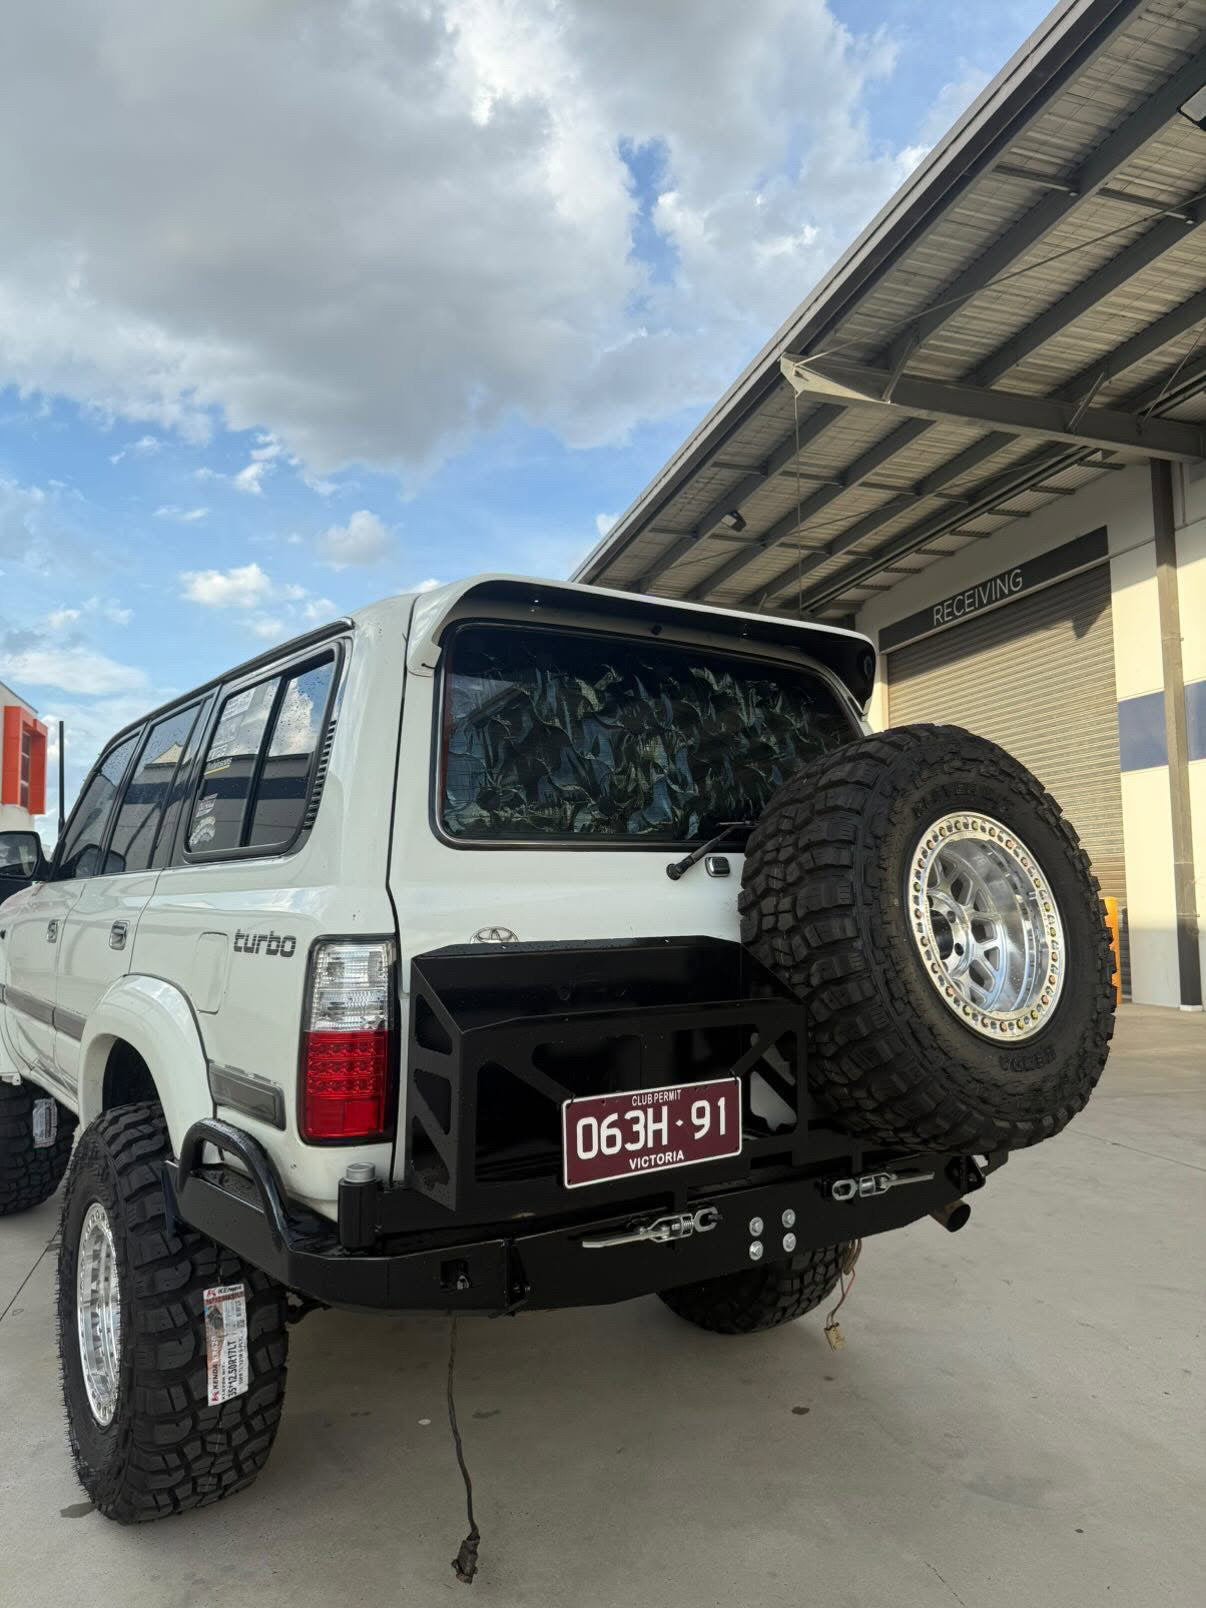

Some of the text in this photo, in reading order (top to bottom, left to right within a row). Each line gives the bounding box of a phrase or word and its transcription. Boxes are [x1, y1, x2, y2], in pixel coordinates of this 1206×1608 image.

[933, 569, 1023, 626] RECEIVING
[233, 928, 297, 958] turbo
[631, 1089, 682, 1106] CLUB PERMIT
[576, 1105, 668, 1160] 063H
[629, 1149, 685, 1170] VICTORIA
